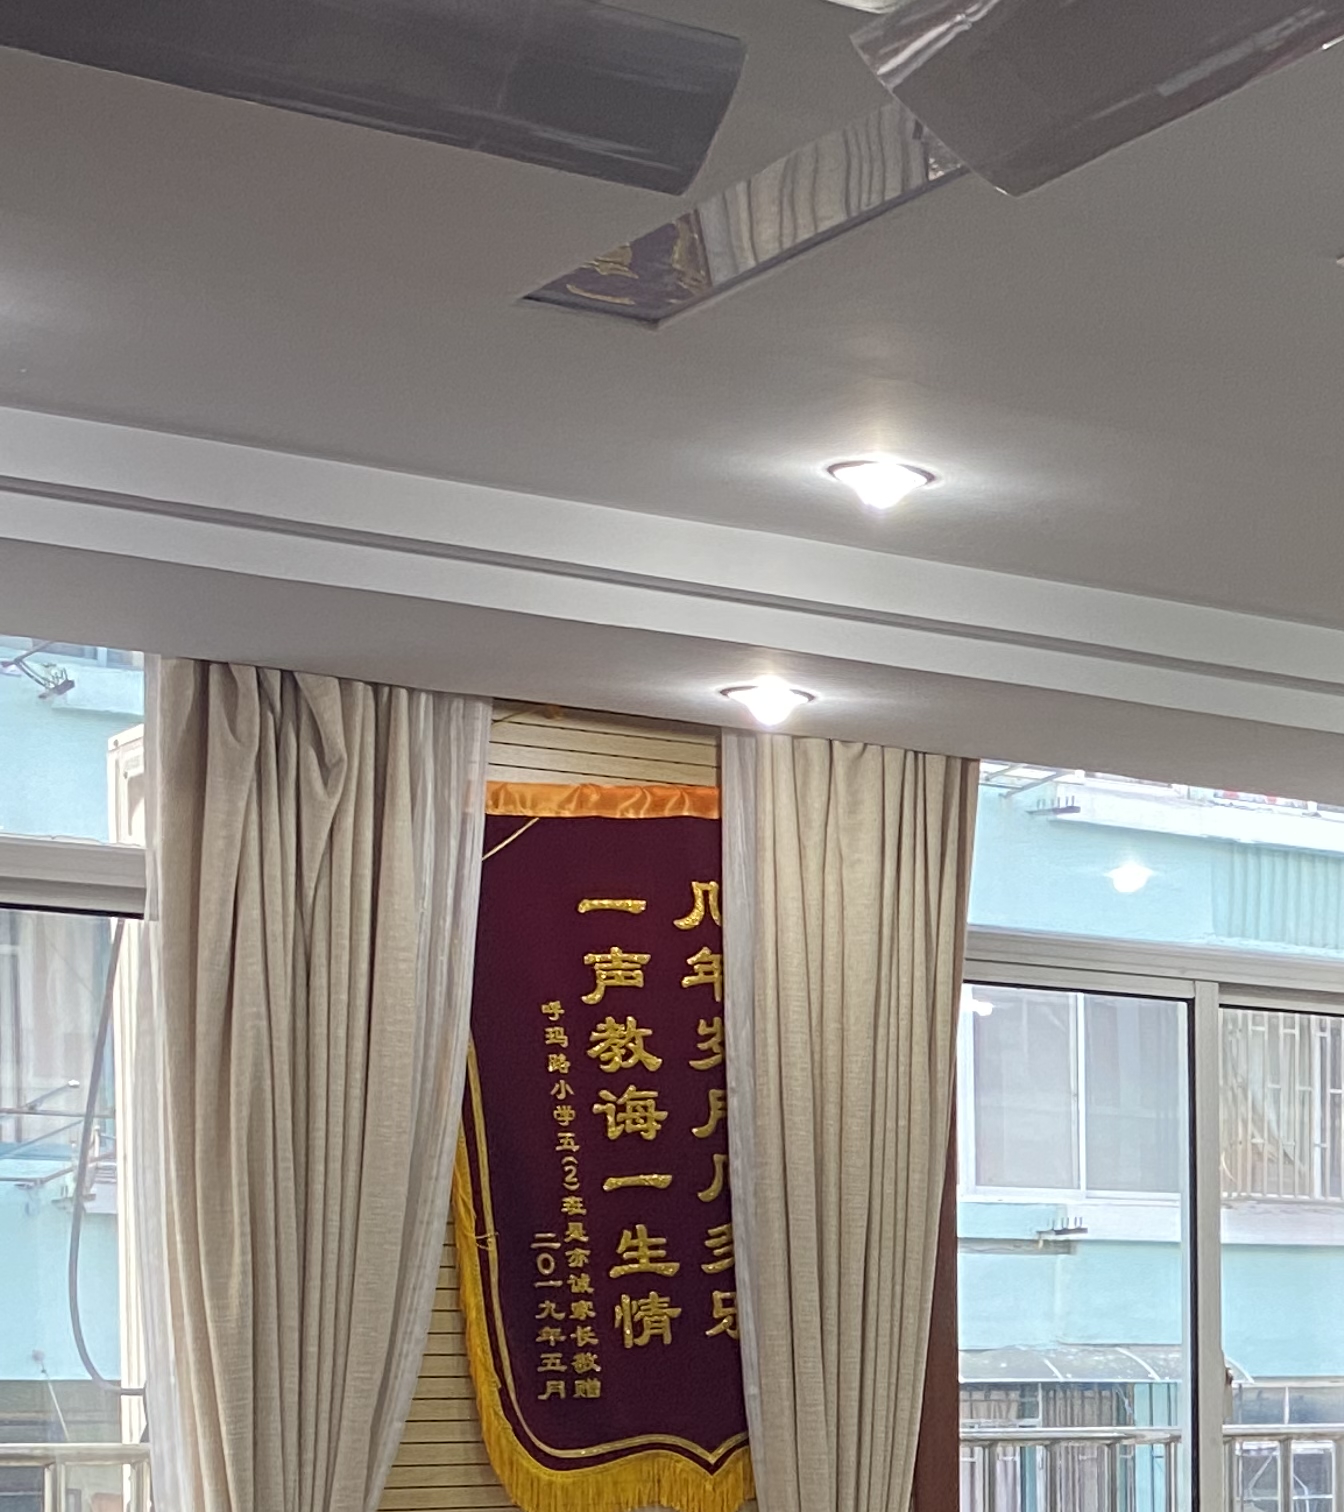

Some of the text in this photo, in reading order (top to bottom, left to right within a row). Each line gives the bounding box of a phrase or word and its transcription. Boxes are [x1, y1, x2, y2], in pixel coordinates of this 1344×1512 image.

[577, 897, 682, 1349] 一声教诲一生情
